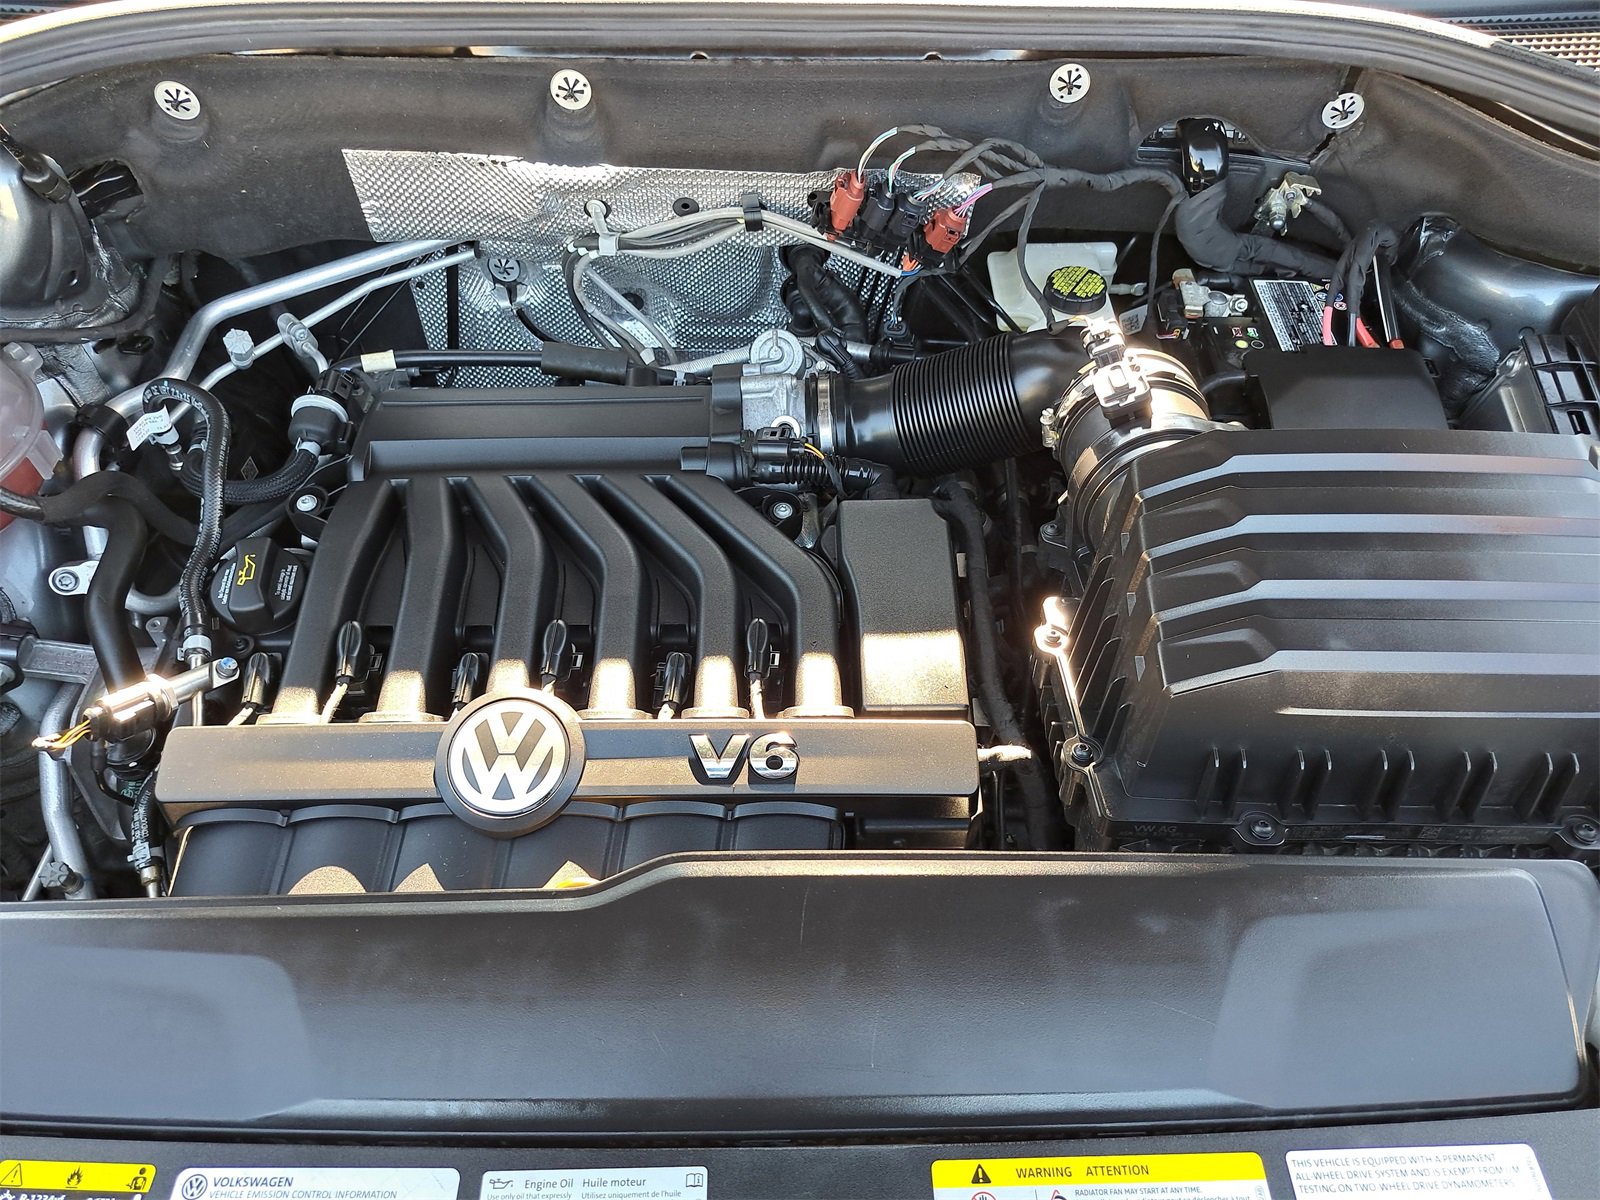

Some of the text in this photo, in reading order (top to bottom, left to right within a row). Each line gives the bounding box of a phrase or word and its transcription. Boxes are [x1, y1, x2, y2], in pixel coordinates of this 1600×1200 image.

[456, 704, 561, 808] VW
[688, 731, 800, 784] V6
[1292, 1159, 1312, 1168] THIS
[1313, 1158, 1350, 1168] VEHICLE
[1352, 1157, 1361, 1166] IS
[1363, 1156, 1407, 1167] EQUIPPED
[1408, 1155, 1432, 1165] WITH
[1443, 1153, 1496, 1163] PERMANENT
[1016, 1164, 1150, 1179] WARNING ATTENTION
[1347, 1170, 1373, 1179] DRIVE
[1375, 1168, 1409, 1178] SYSTEM
[1410, 1168, 1431, 1177] AND
[1433, 1168, 1441, 1176] IS
[1443, 1167, 1478, 1176] EXEMPT
[1479, 1166, 1504, 1175] FROM
[213, 1177, 294, 1188] VOLKSWAGEN
[524, 1178, 574, 1191] Engine Oil
[582, 1178, 647, 1188] Huile moteur
[1298, 1184, 1337, 1194] TESTING
[1338, 1182, 1353, 1192] ON
[1413, 1180, 1440, 1190] DRIVE
[1442, 1178, 1516, 1189] DYNAMOMETERS
[209, 1190, 398, 1199] VEHICLE EMISSION CONTROL INFORMATION
[487, 1192, 500, 1200] Use
[501, 1192, 515, 1200] only
[541, 1191, 572, 1200] expressly
[581, 1192, 607, 1200] Utilisez
[608, 1191, 650, 1200] uniquement
[651, 1190, 660, 1198] de
[1075, 1188, 1108, 1196] RADIATOR
[1140, 1187, 1159, 1195] START
[1170, 1186, 1183, 1194] ANY
